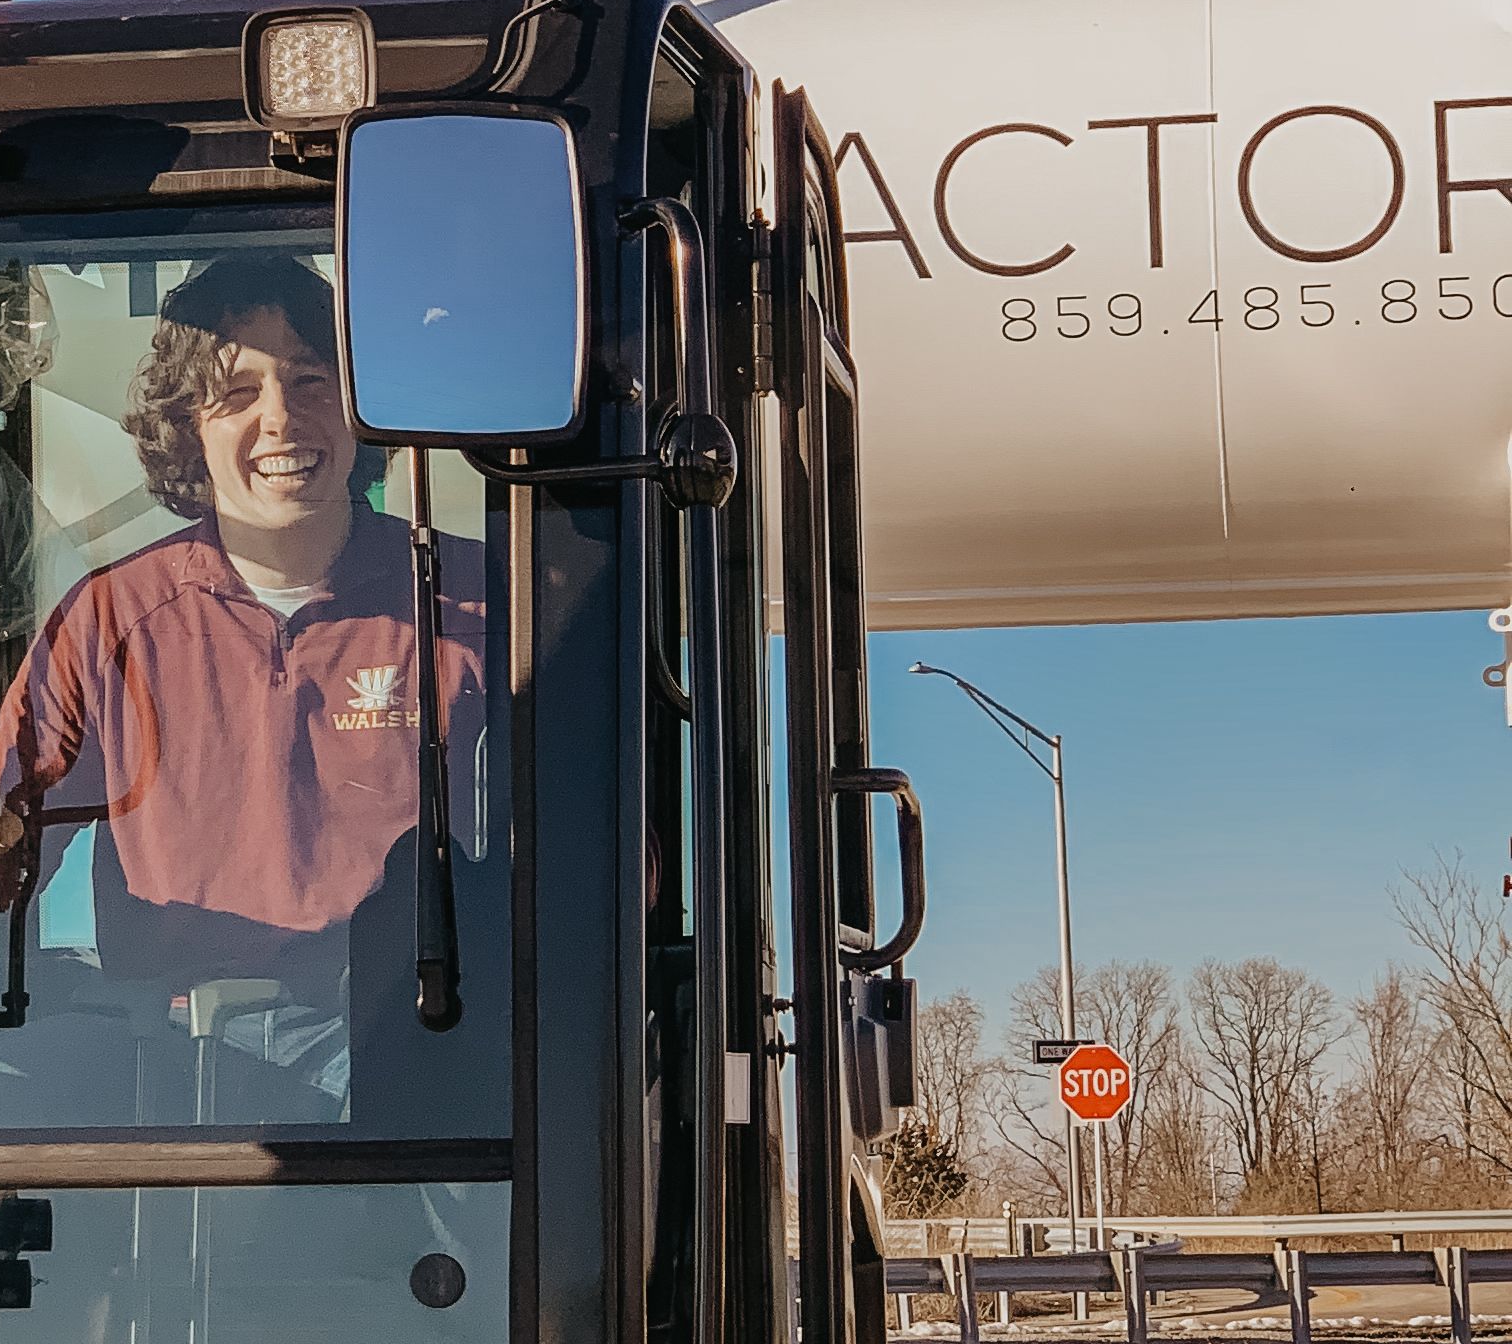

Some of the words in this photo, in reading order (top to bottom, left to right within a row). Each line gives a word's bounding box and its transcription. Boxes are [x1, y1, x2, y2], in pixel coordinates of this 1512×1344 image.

[332, 710, 420, 731] WALSH
[1041, 1047, 1059, 1056] ONE
[1064, 1068, 1127, 1098] STOP
